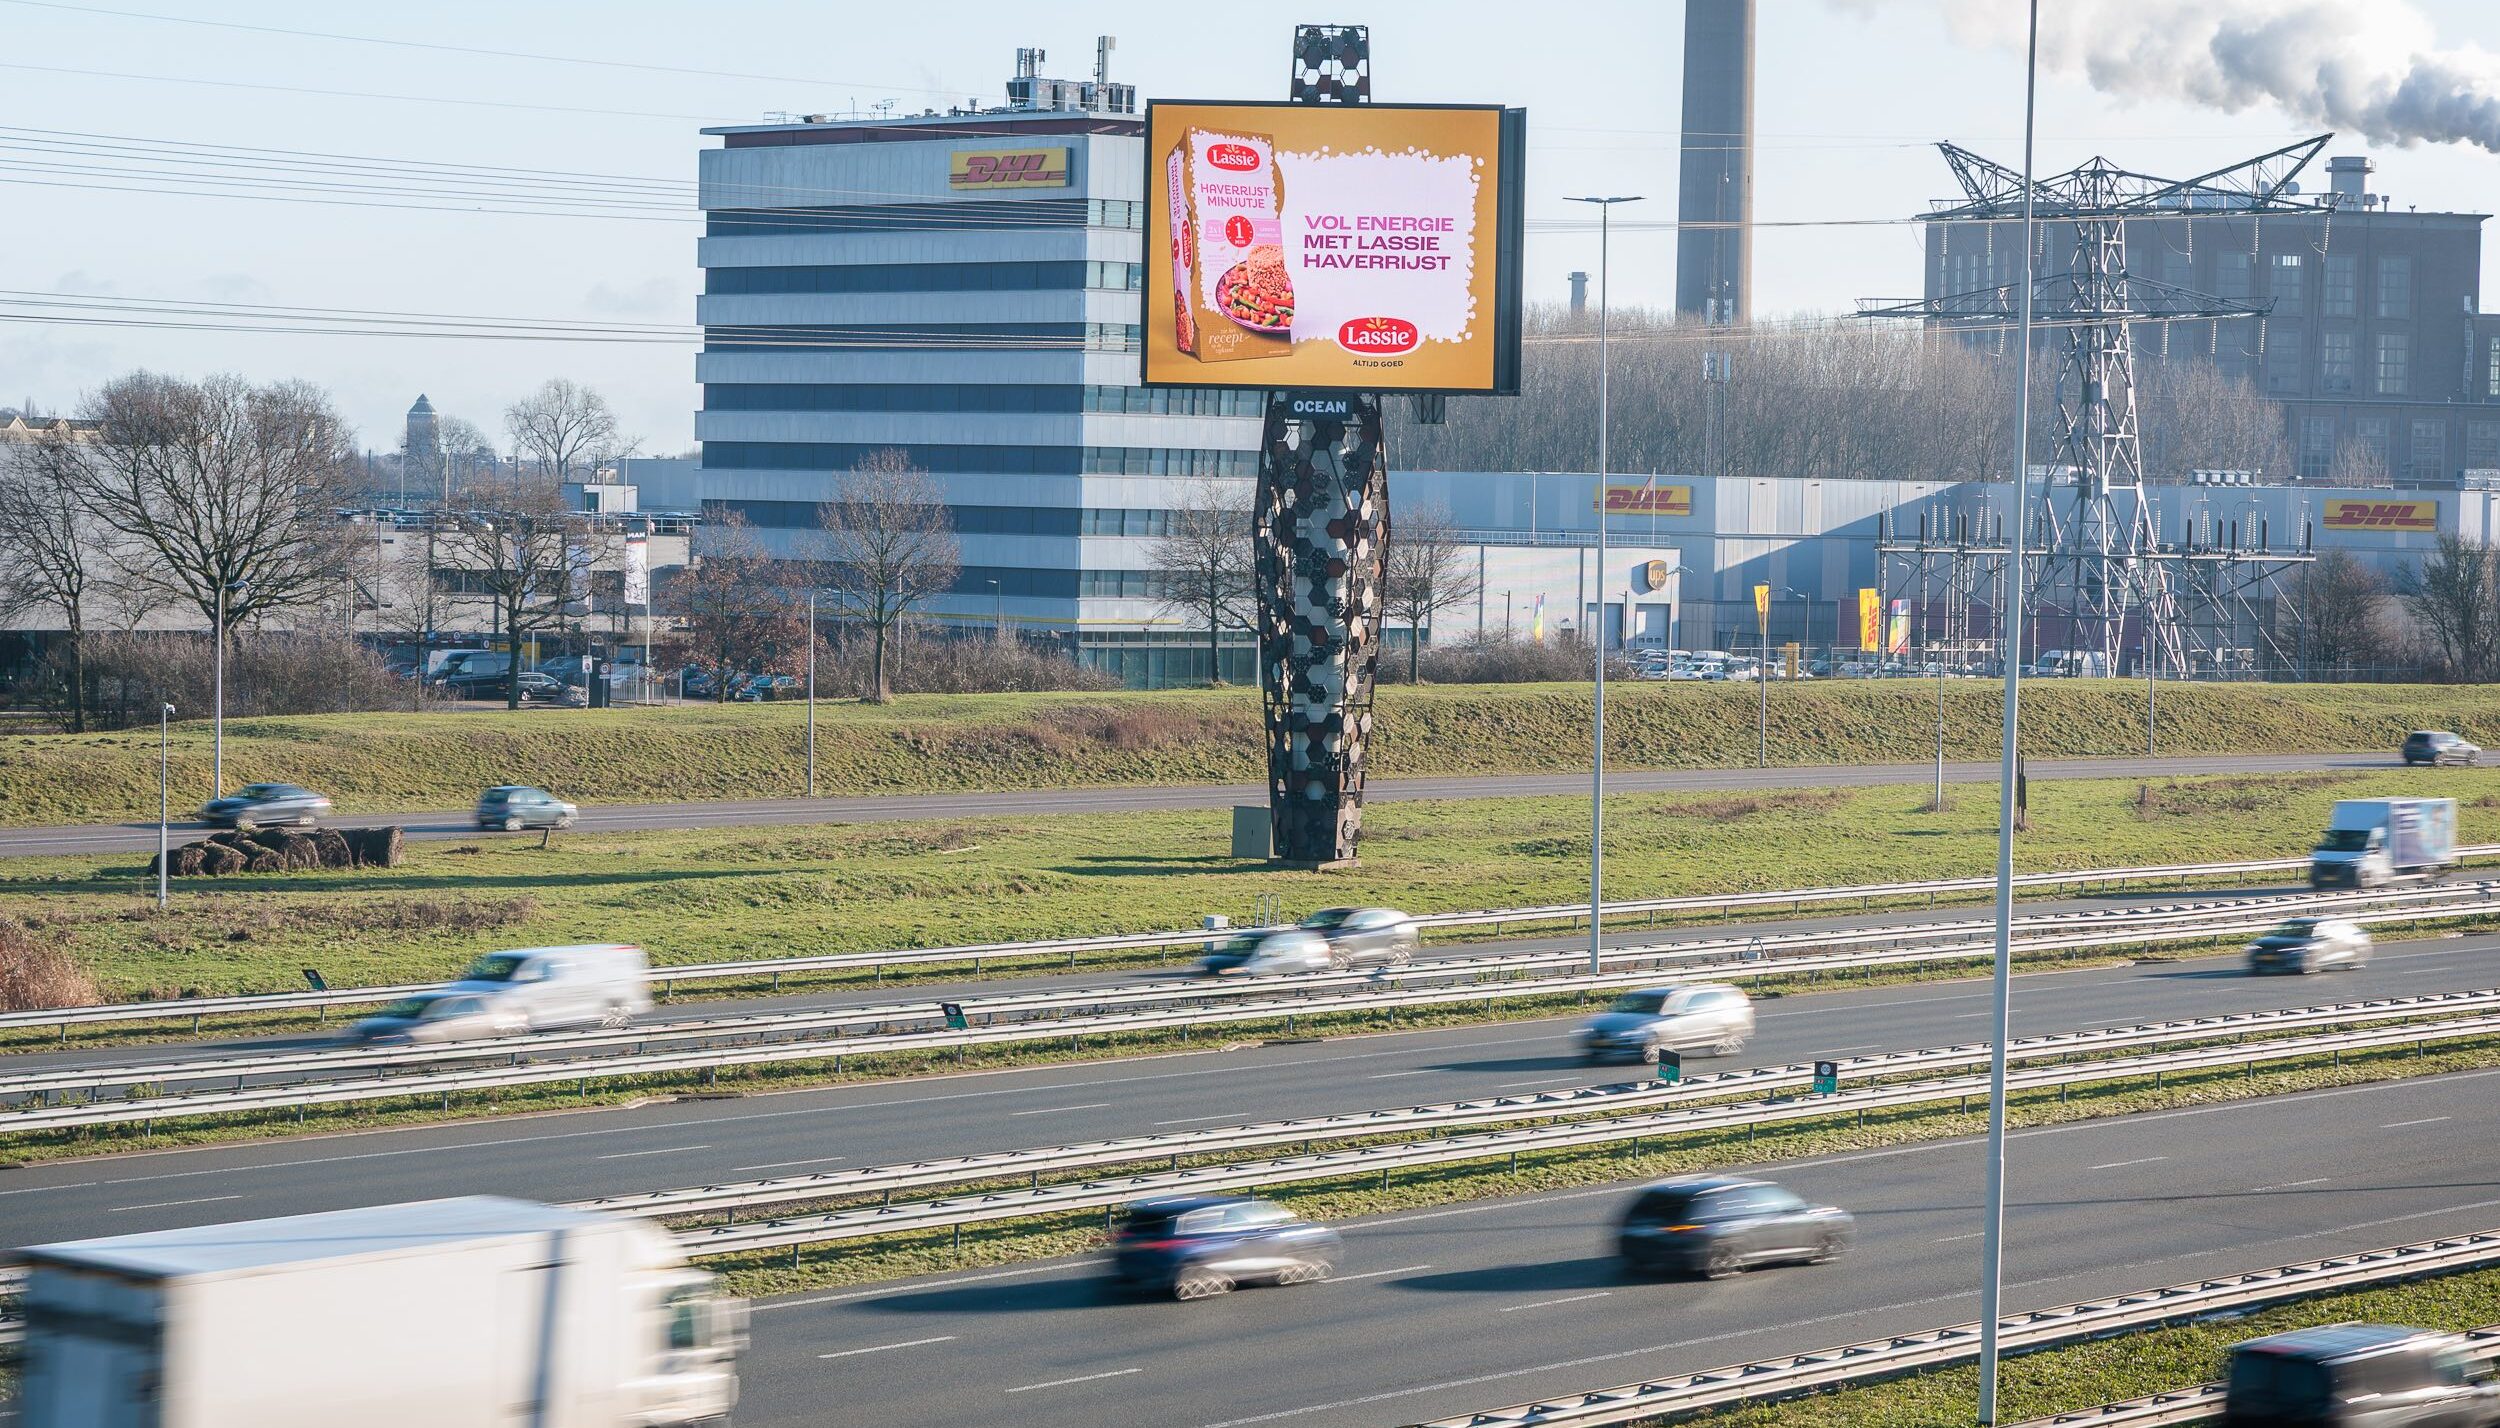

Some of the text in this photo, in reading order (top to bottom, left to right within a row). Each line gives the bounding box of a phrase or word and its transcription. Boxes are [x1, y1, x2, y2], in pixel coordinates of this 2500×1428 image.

[1212, 149, 1255, 167] Lassie
[967, 154, 1047, 183] DHL
[1201, 183, 1269, 197] HAVERRIJST
[1207, 196, 1265, 209] MINUUTJE
[1235, 222, 1244, 239] 1
[1304, 215, 1454, 232] VOL ENERGIE
[1304, 235, 1440, 251] MET LASSIE
[1303, 254, 1451, 270] HAVERRIJST
[1208, 332, 1244, 347] recept
[1346, 325, 1409, 345] Lassie
[1353, 359, 1404, 368] ALTIJD GOED
[1293, 400, 1347, 413] OCEAN
[1606, 489, 1675, 510] DHL
[2340, 504, 2418, 526] DHL
